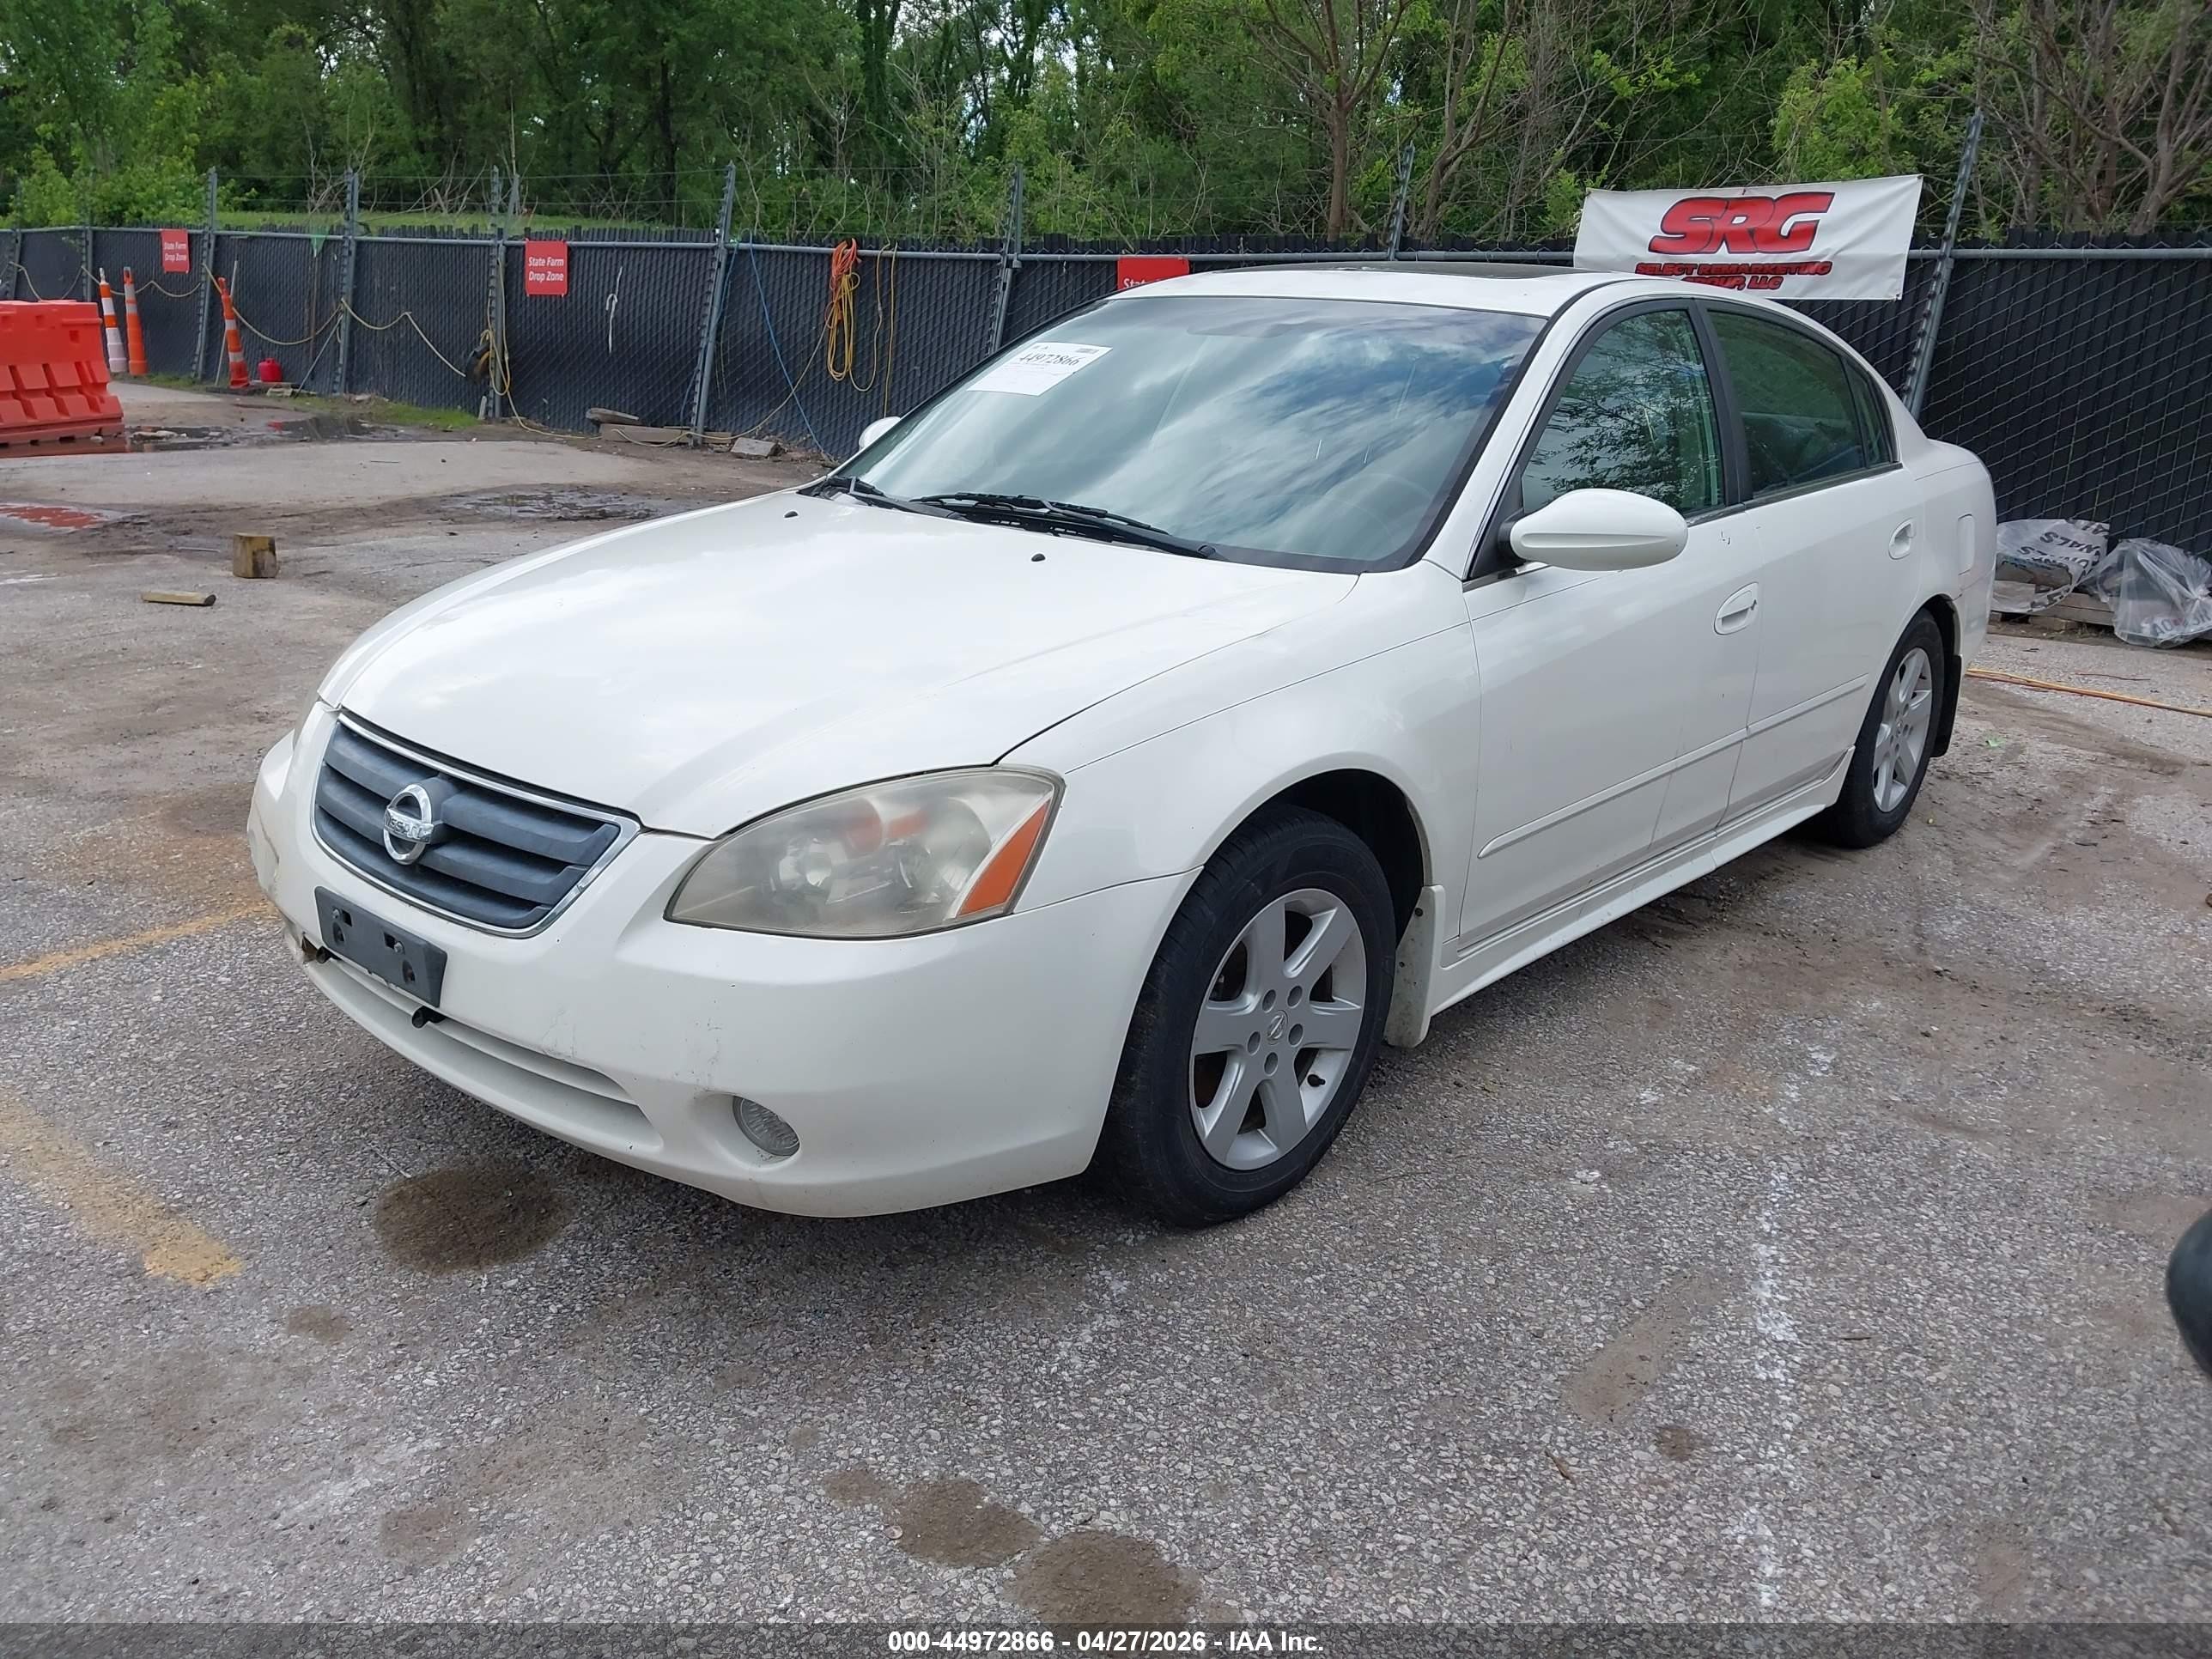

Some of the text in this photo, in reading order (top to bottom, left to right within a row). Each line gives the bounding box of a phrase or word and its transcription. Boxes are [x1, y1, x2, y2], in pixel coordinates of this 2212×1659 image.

[1648, 191, 1835, 255] SRG
[528, 257, 564, 267] State Farm
[1635, 261, 1832, 276] SELECT REMARKETING
[528, 270, 564, 283] Drop Zone
[1747, 276, 1784, 289] LLC
[1019, 351, 1080, 366] 44972866
